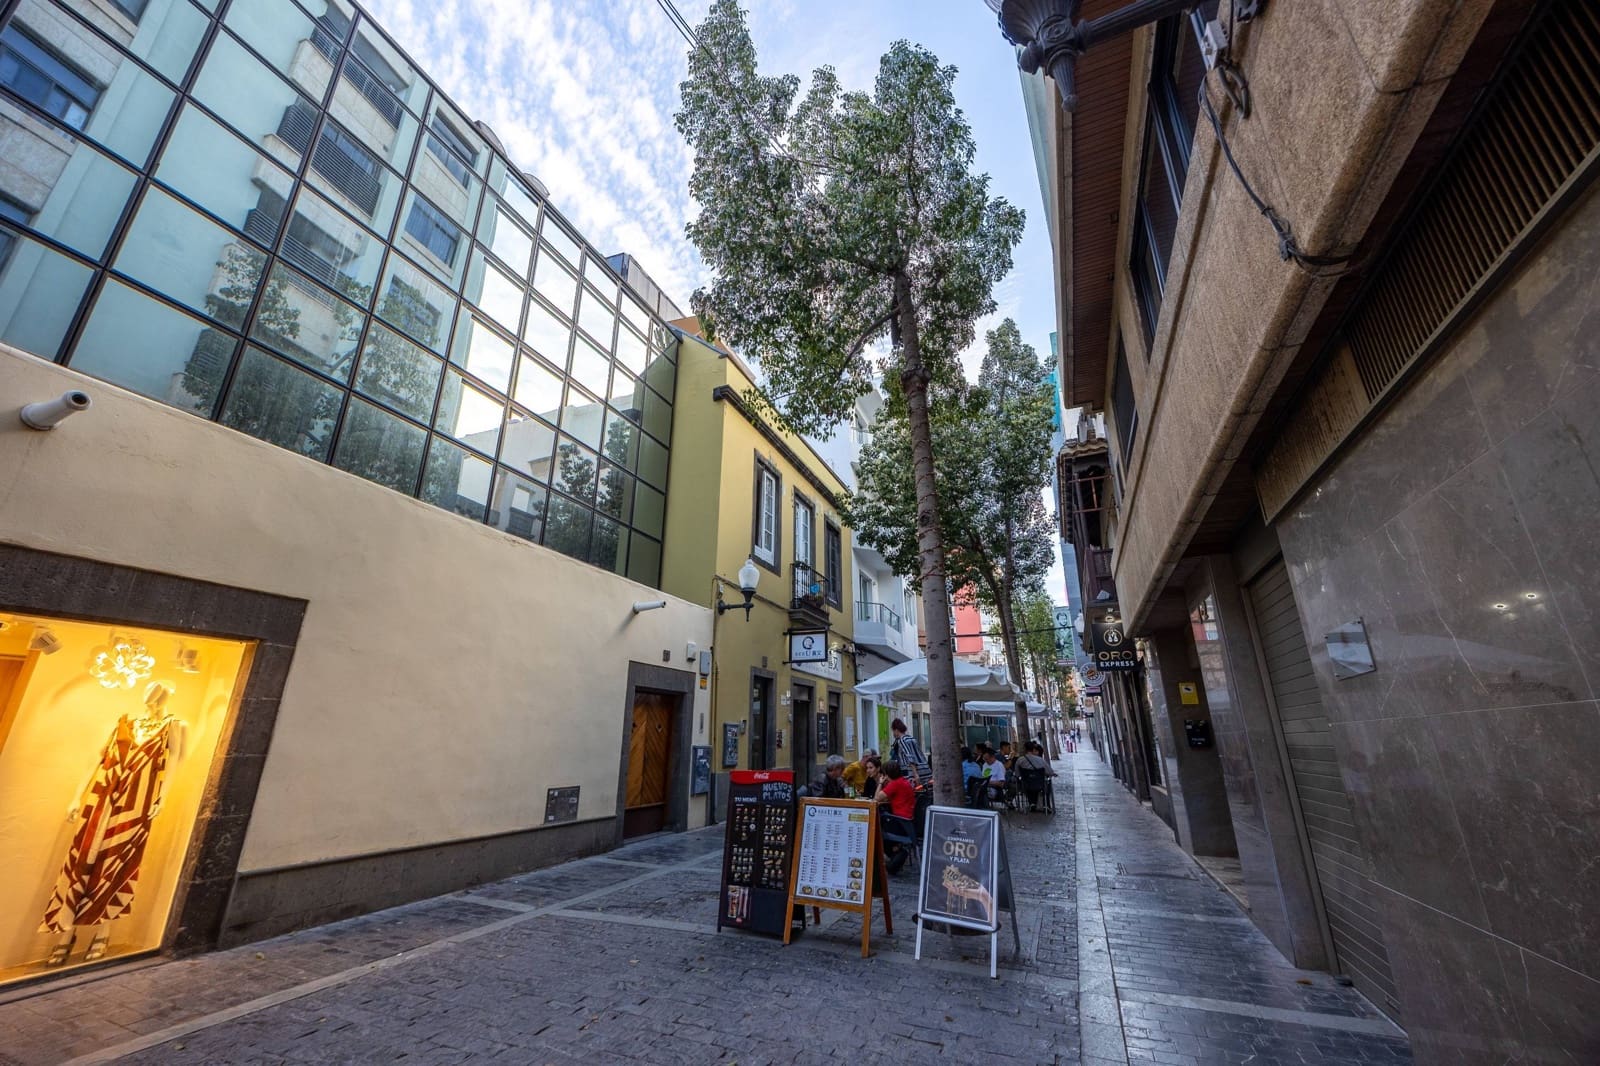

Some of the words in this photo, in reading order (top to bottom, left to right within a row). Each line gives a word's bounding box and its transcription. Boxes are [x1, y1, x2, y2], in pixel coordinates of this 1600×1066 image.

[1099, 650, 1133, 661] ORO
[763, 782, 792, 792] NUEVOS
[763, 791, 791, 801] PLATOS
[943, 840, 978, 859] ORO
